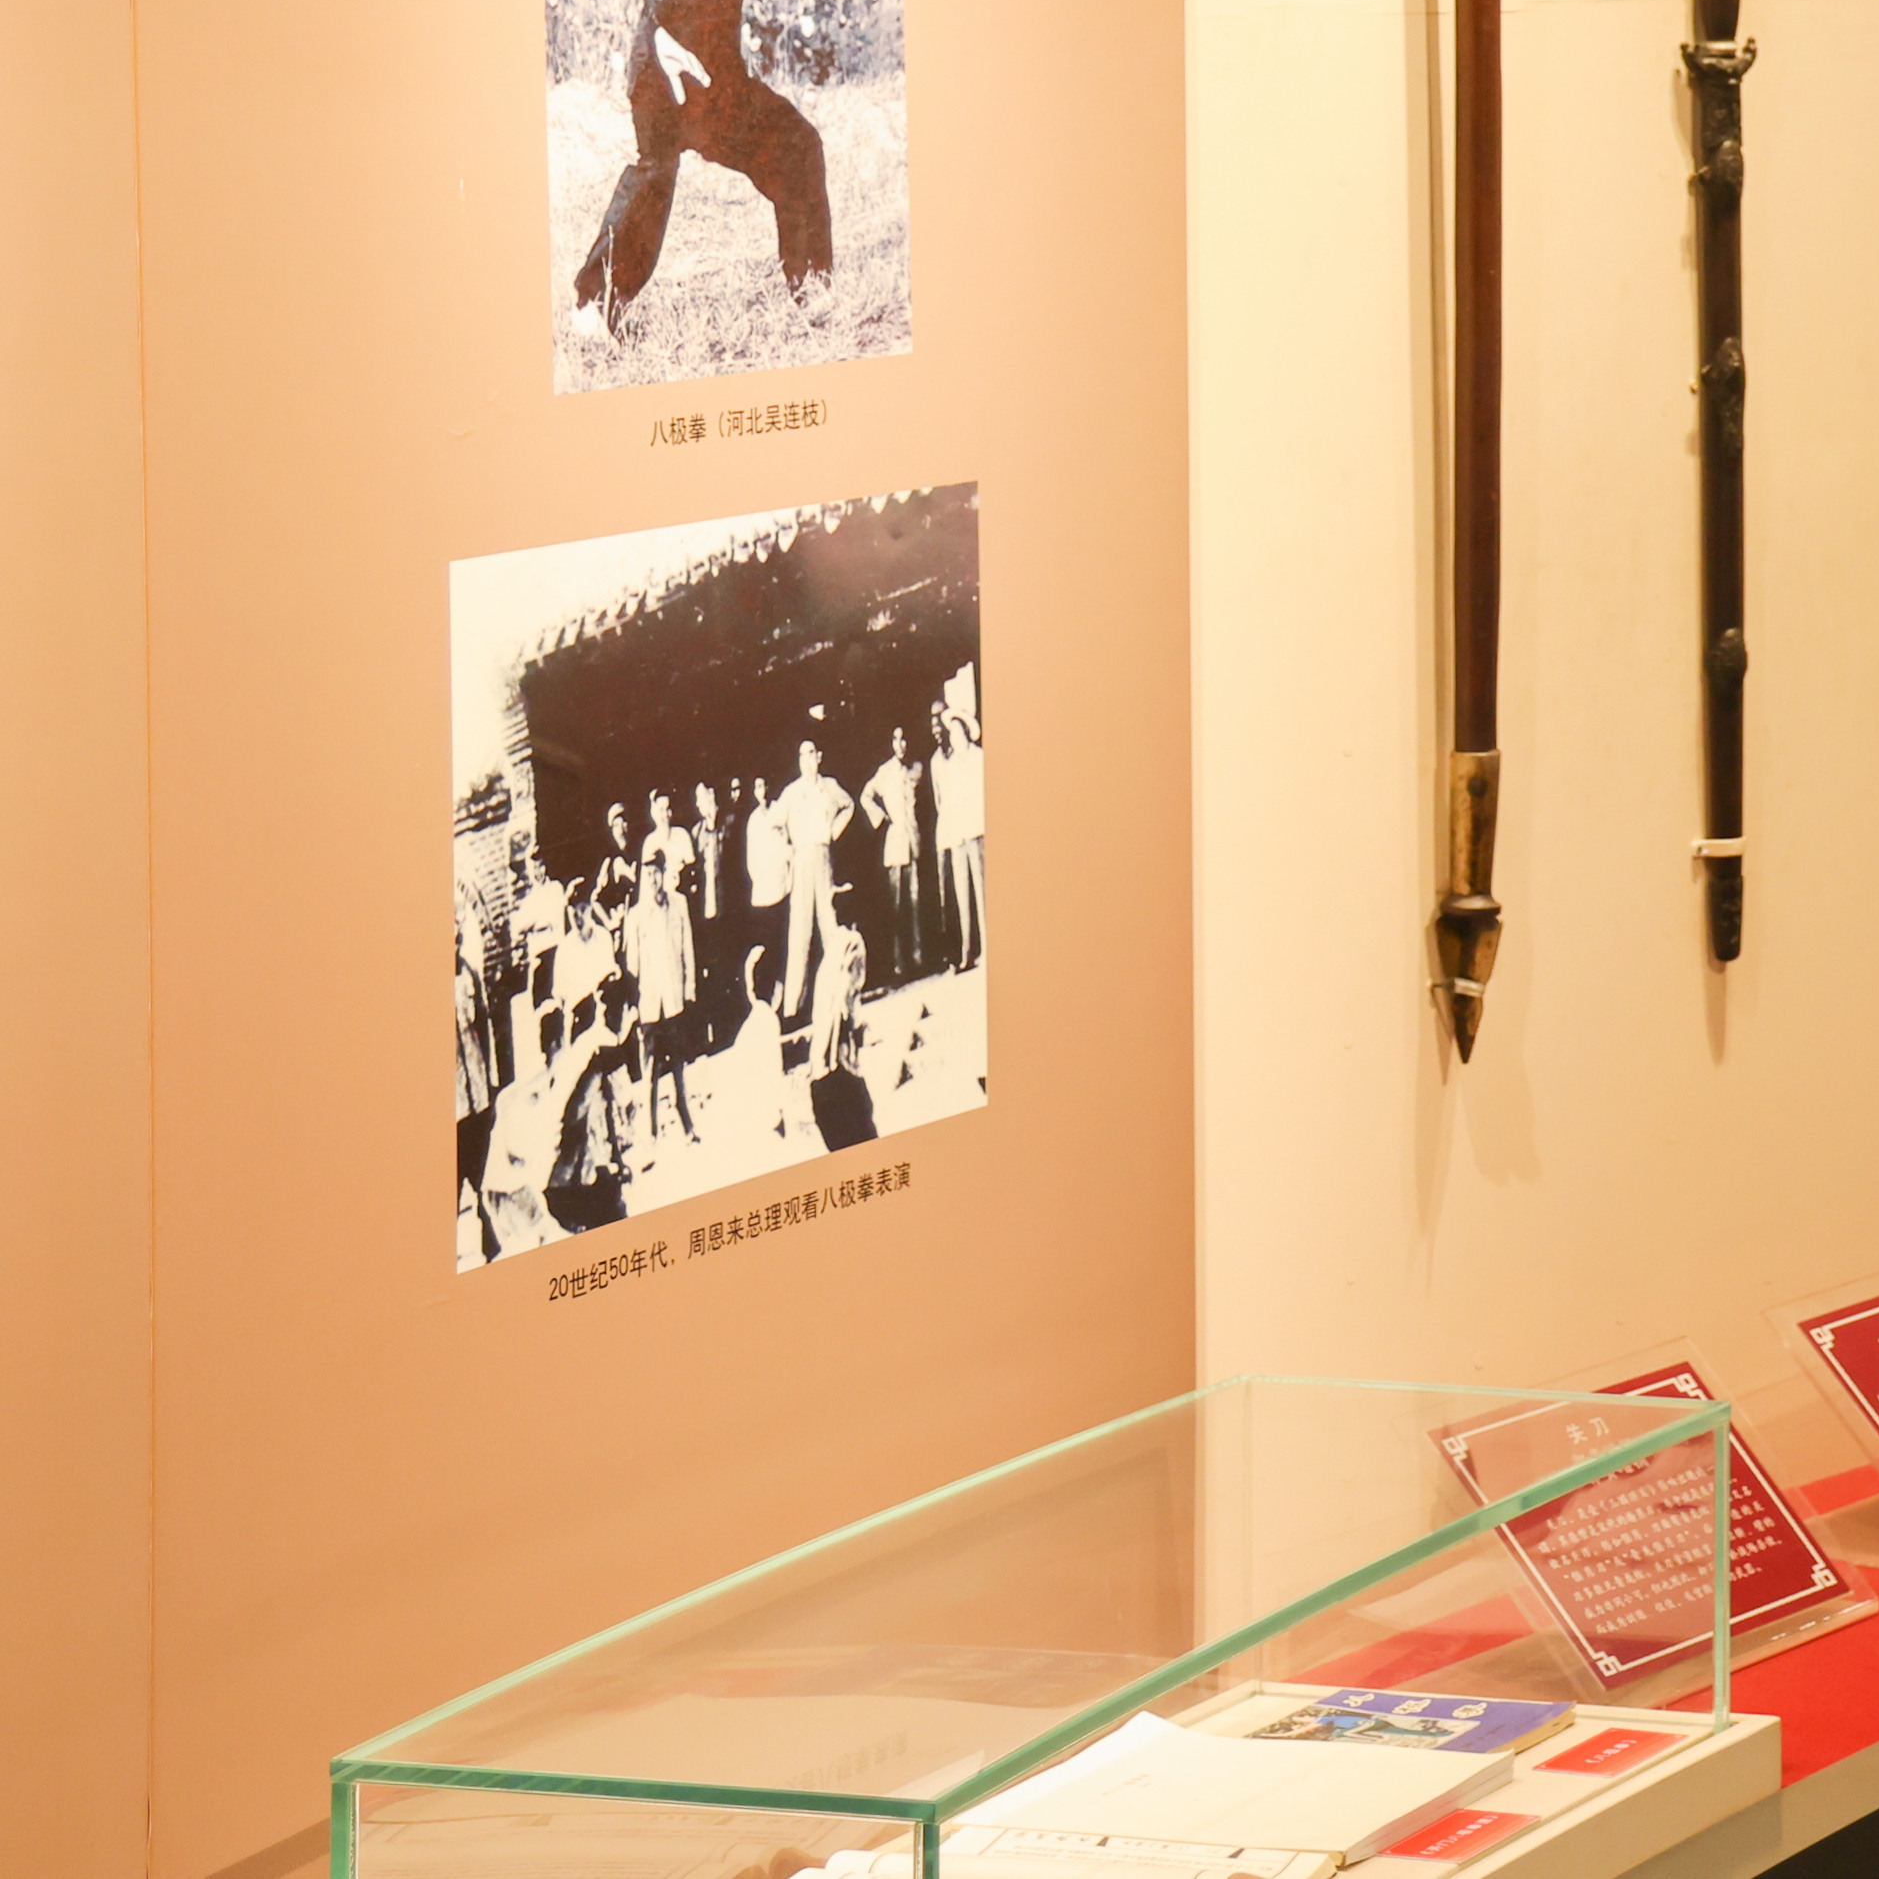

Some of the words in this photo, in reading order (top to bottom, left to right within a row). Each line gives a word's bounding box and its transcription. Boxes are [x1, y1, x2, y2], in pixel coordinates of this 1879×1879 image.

[650, 399, 828, 448] 八极拳（河北吴连枝）
